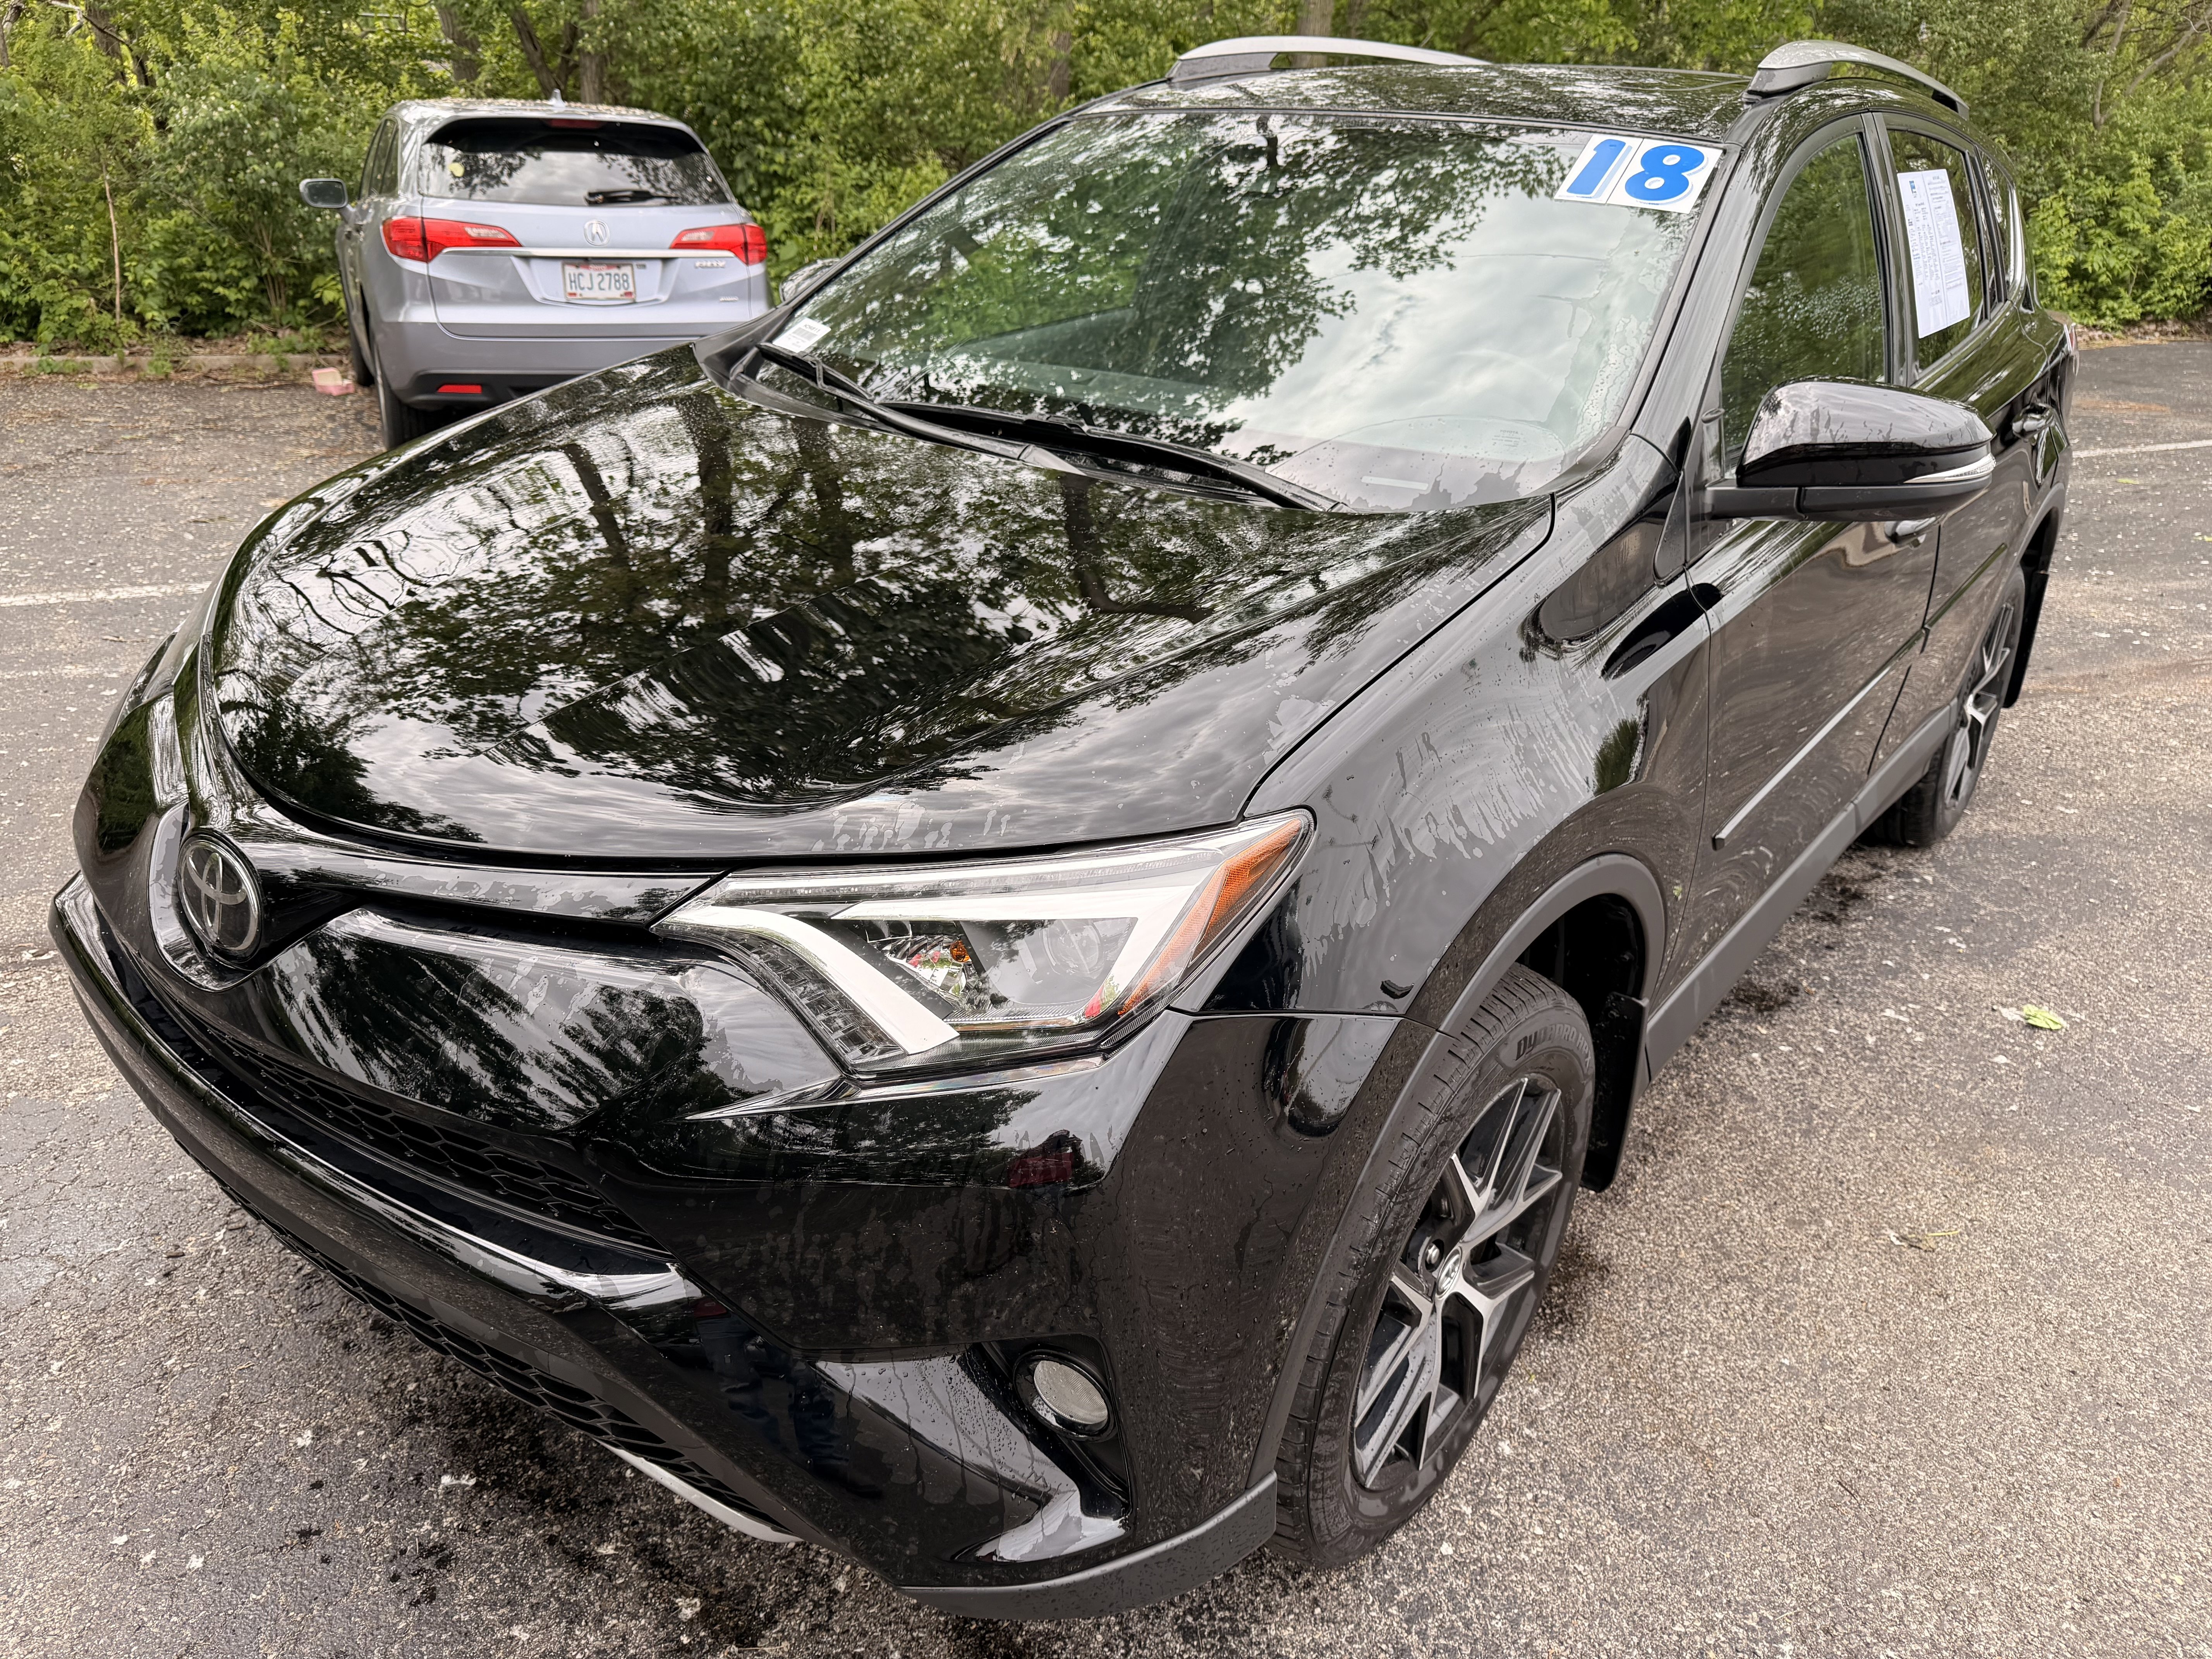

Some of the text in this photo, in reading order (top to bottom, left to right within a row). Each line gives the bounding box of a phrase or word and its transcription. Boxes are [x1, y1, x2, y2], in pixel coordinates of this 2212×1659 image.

[1566, 139, 1709, 201] 18
[568, 273, 630, 290] HCJ 2788
